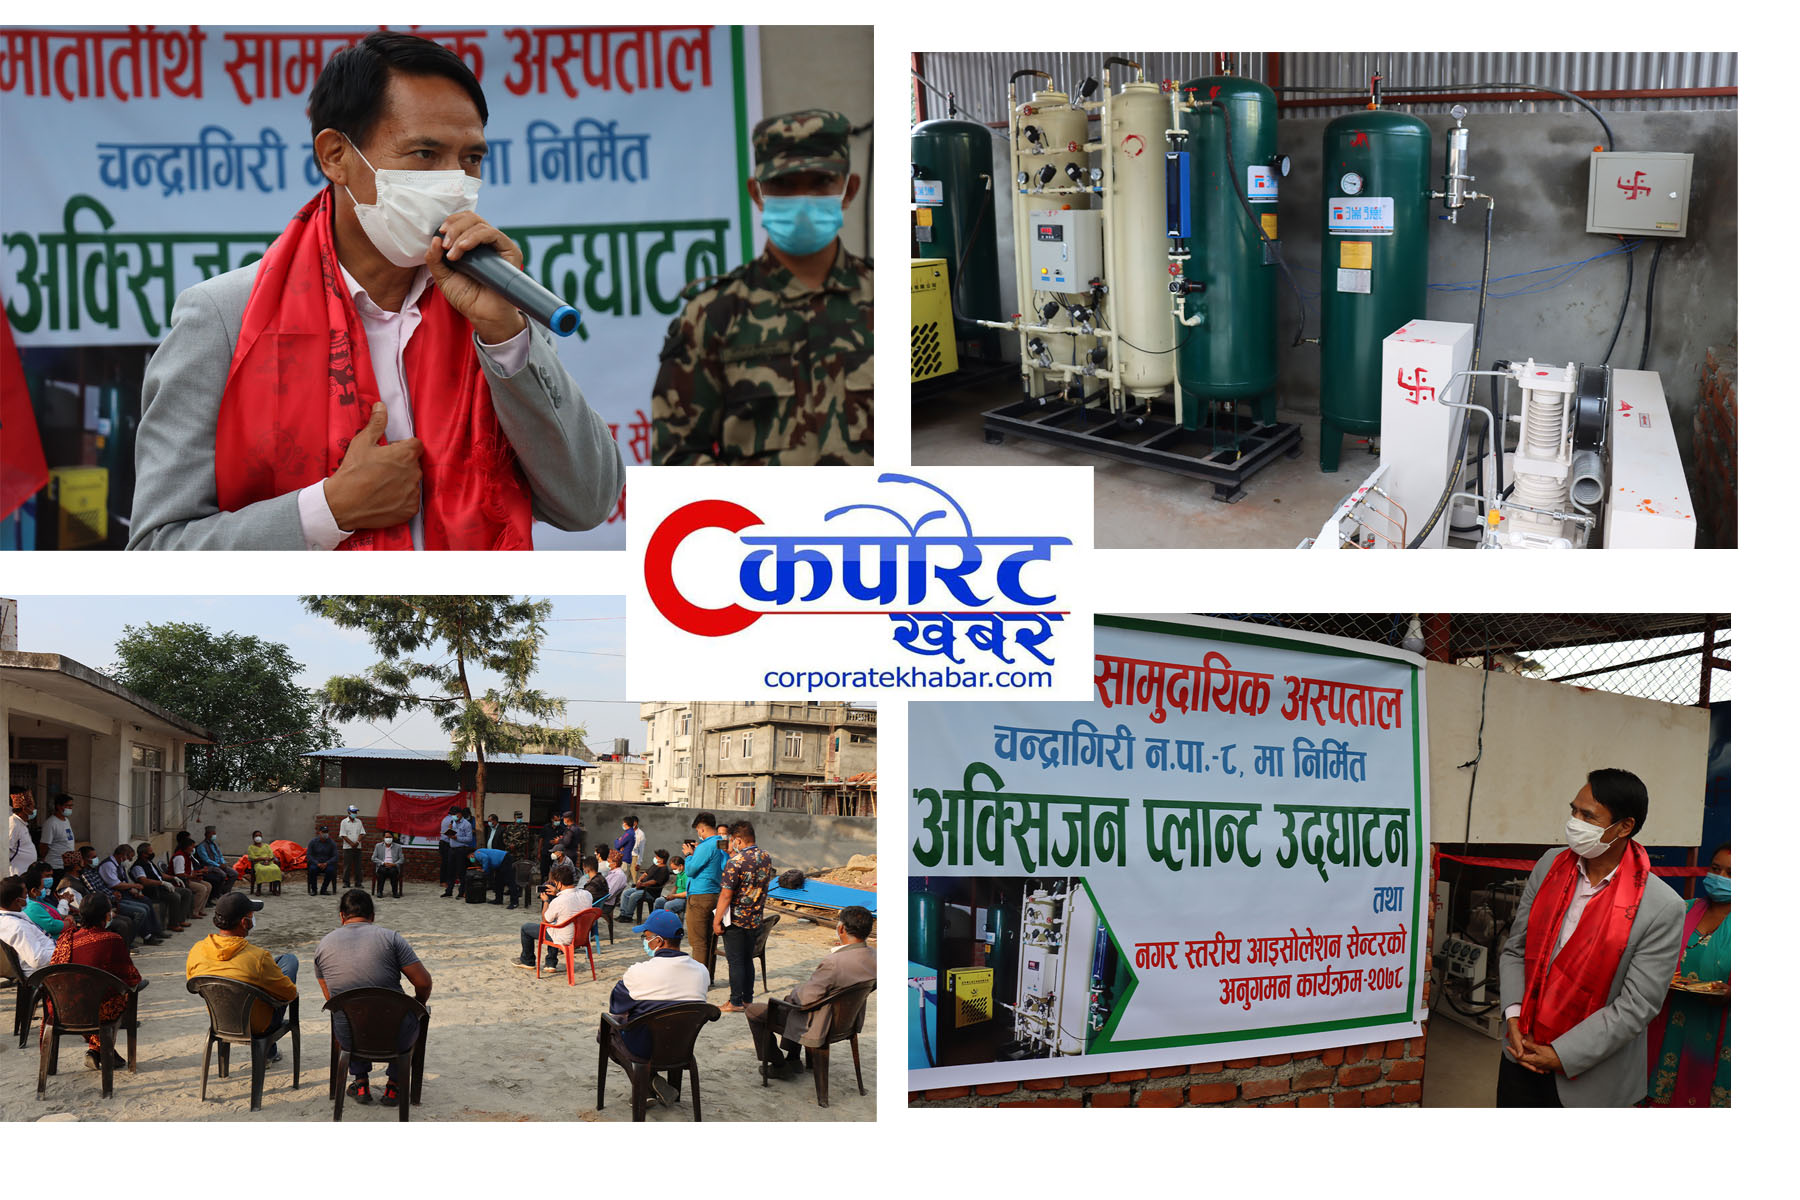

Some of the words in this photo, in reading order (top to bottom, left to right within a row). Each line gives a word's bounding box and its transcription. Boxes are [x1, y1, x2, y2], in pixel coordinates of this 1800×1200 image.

[503, 25, 715, 99] अस्पताल
[96, 124, 288, 198] चन्द्रागिरी
[526, 117, 651, 184] निर्मित
[1094, 651, 1274, 724] सामुदायिक
[1280, 675, 1404, 730] अस्पताल
[994, 719, 1136, 771] चन्द्रागिरी
[1254, 745, 1285, 777] मा
[1293, 737, 1368, 783] निर्मित
[912, 761, 1130, 874] अक्सिजन
[1143, 799, 1262, 872] प्लान्ट
[1372, 886, 1405, 914] तथा
[1135, 941, 1180, 970] नगर
[1184, 931, 1242, 969] स्तरीय
[1246, 927, 1343, 967] आइसोलेशन
[1346, 923, 1408, 960] सेन्टरको
[1219, 974, 1293, 1011] अनुगमन
